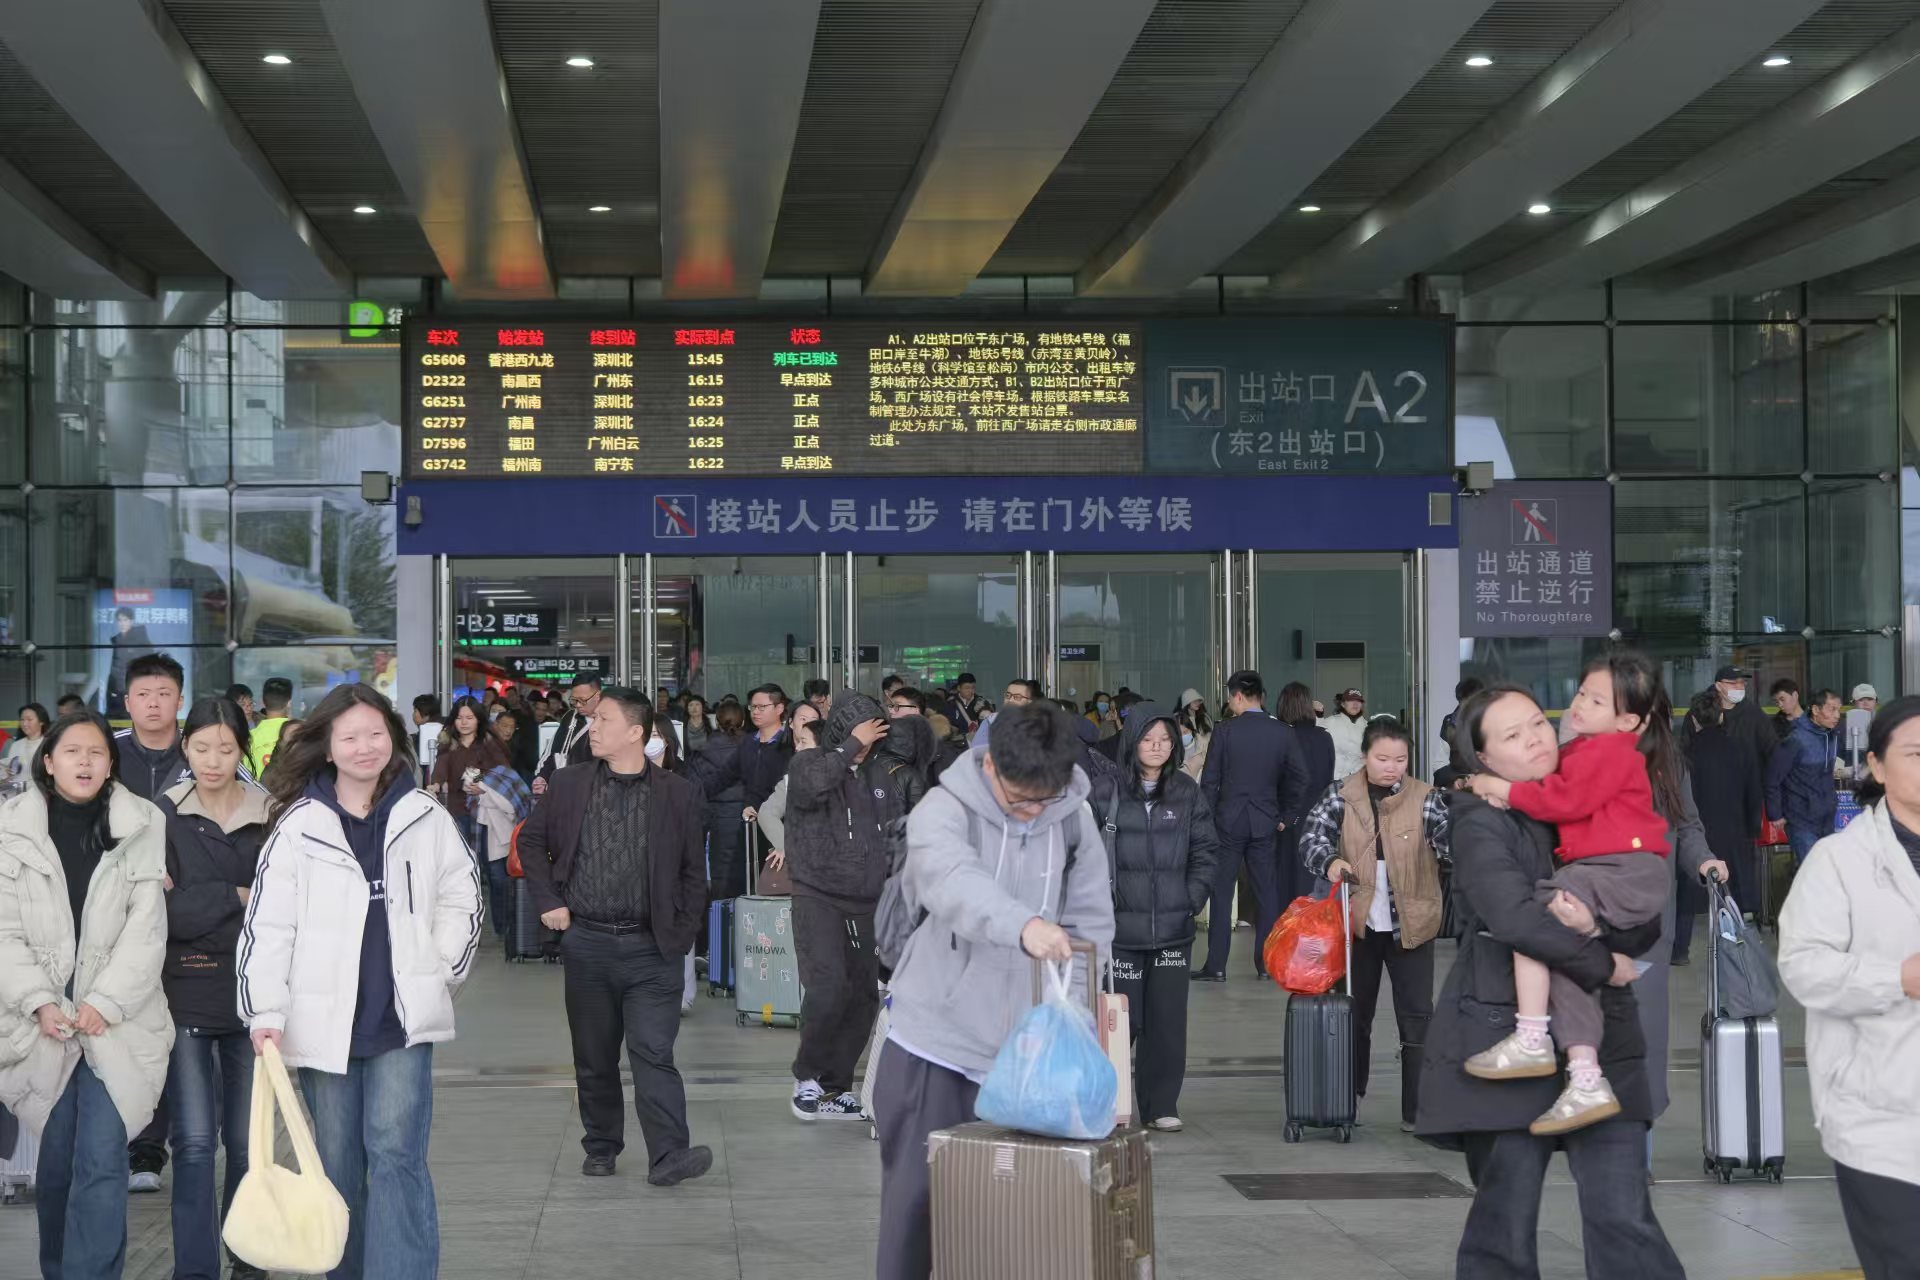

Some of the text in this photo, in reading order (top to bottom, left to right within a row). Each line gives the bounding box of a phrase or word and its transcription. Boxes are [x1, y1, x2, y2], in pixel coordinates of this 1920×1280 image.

[428, 329, 821, 346] 车次 始发站 终到站 实际到点 状态
[422, 352, 838, 368] G5606 香港西九龙 深圳北 15:45 列车已到达
[422, 372, 832, 389] D2322 南昌西 广州东 16:15 早点到达
[422, 393, 820, 409] G6251 广州南 深圳北 16:23 正点
[1239, 370, 1428, 424] 出站口 A2
[422, 413, 820, 430] G2737 南昌 深圳北 16:24 正点
[1239, 411, 1264, 424] Exit
[422, 434, 820, 451] D7596 福田 广州白云 16:25 正点
[869, 433, 900, 447] 过道。
[422, 455, 832, 472] G3742 福州南 南宁东 16:22 早点到达
[1258, 459, 1329, 470] East Exit 2
[706, 496, 1193, 534] 接站人员止步 请在门外等候
[1477, 549, 1593, 576] 出站通道
[1476, 579, 1594, 605] 禁止逆行
[468, 613, 496, 633] B2
[503, 614, 539, 626] 西广场
[1476, 611, 1593, 625] No Thoroughfare
[558, 659, 576, 671] B2
[745, 945, 787, 956] RIMOWA
[1161, 949, 1182, 958] State
